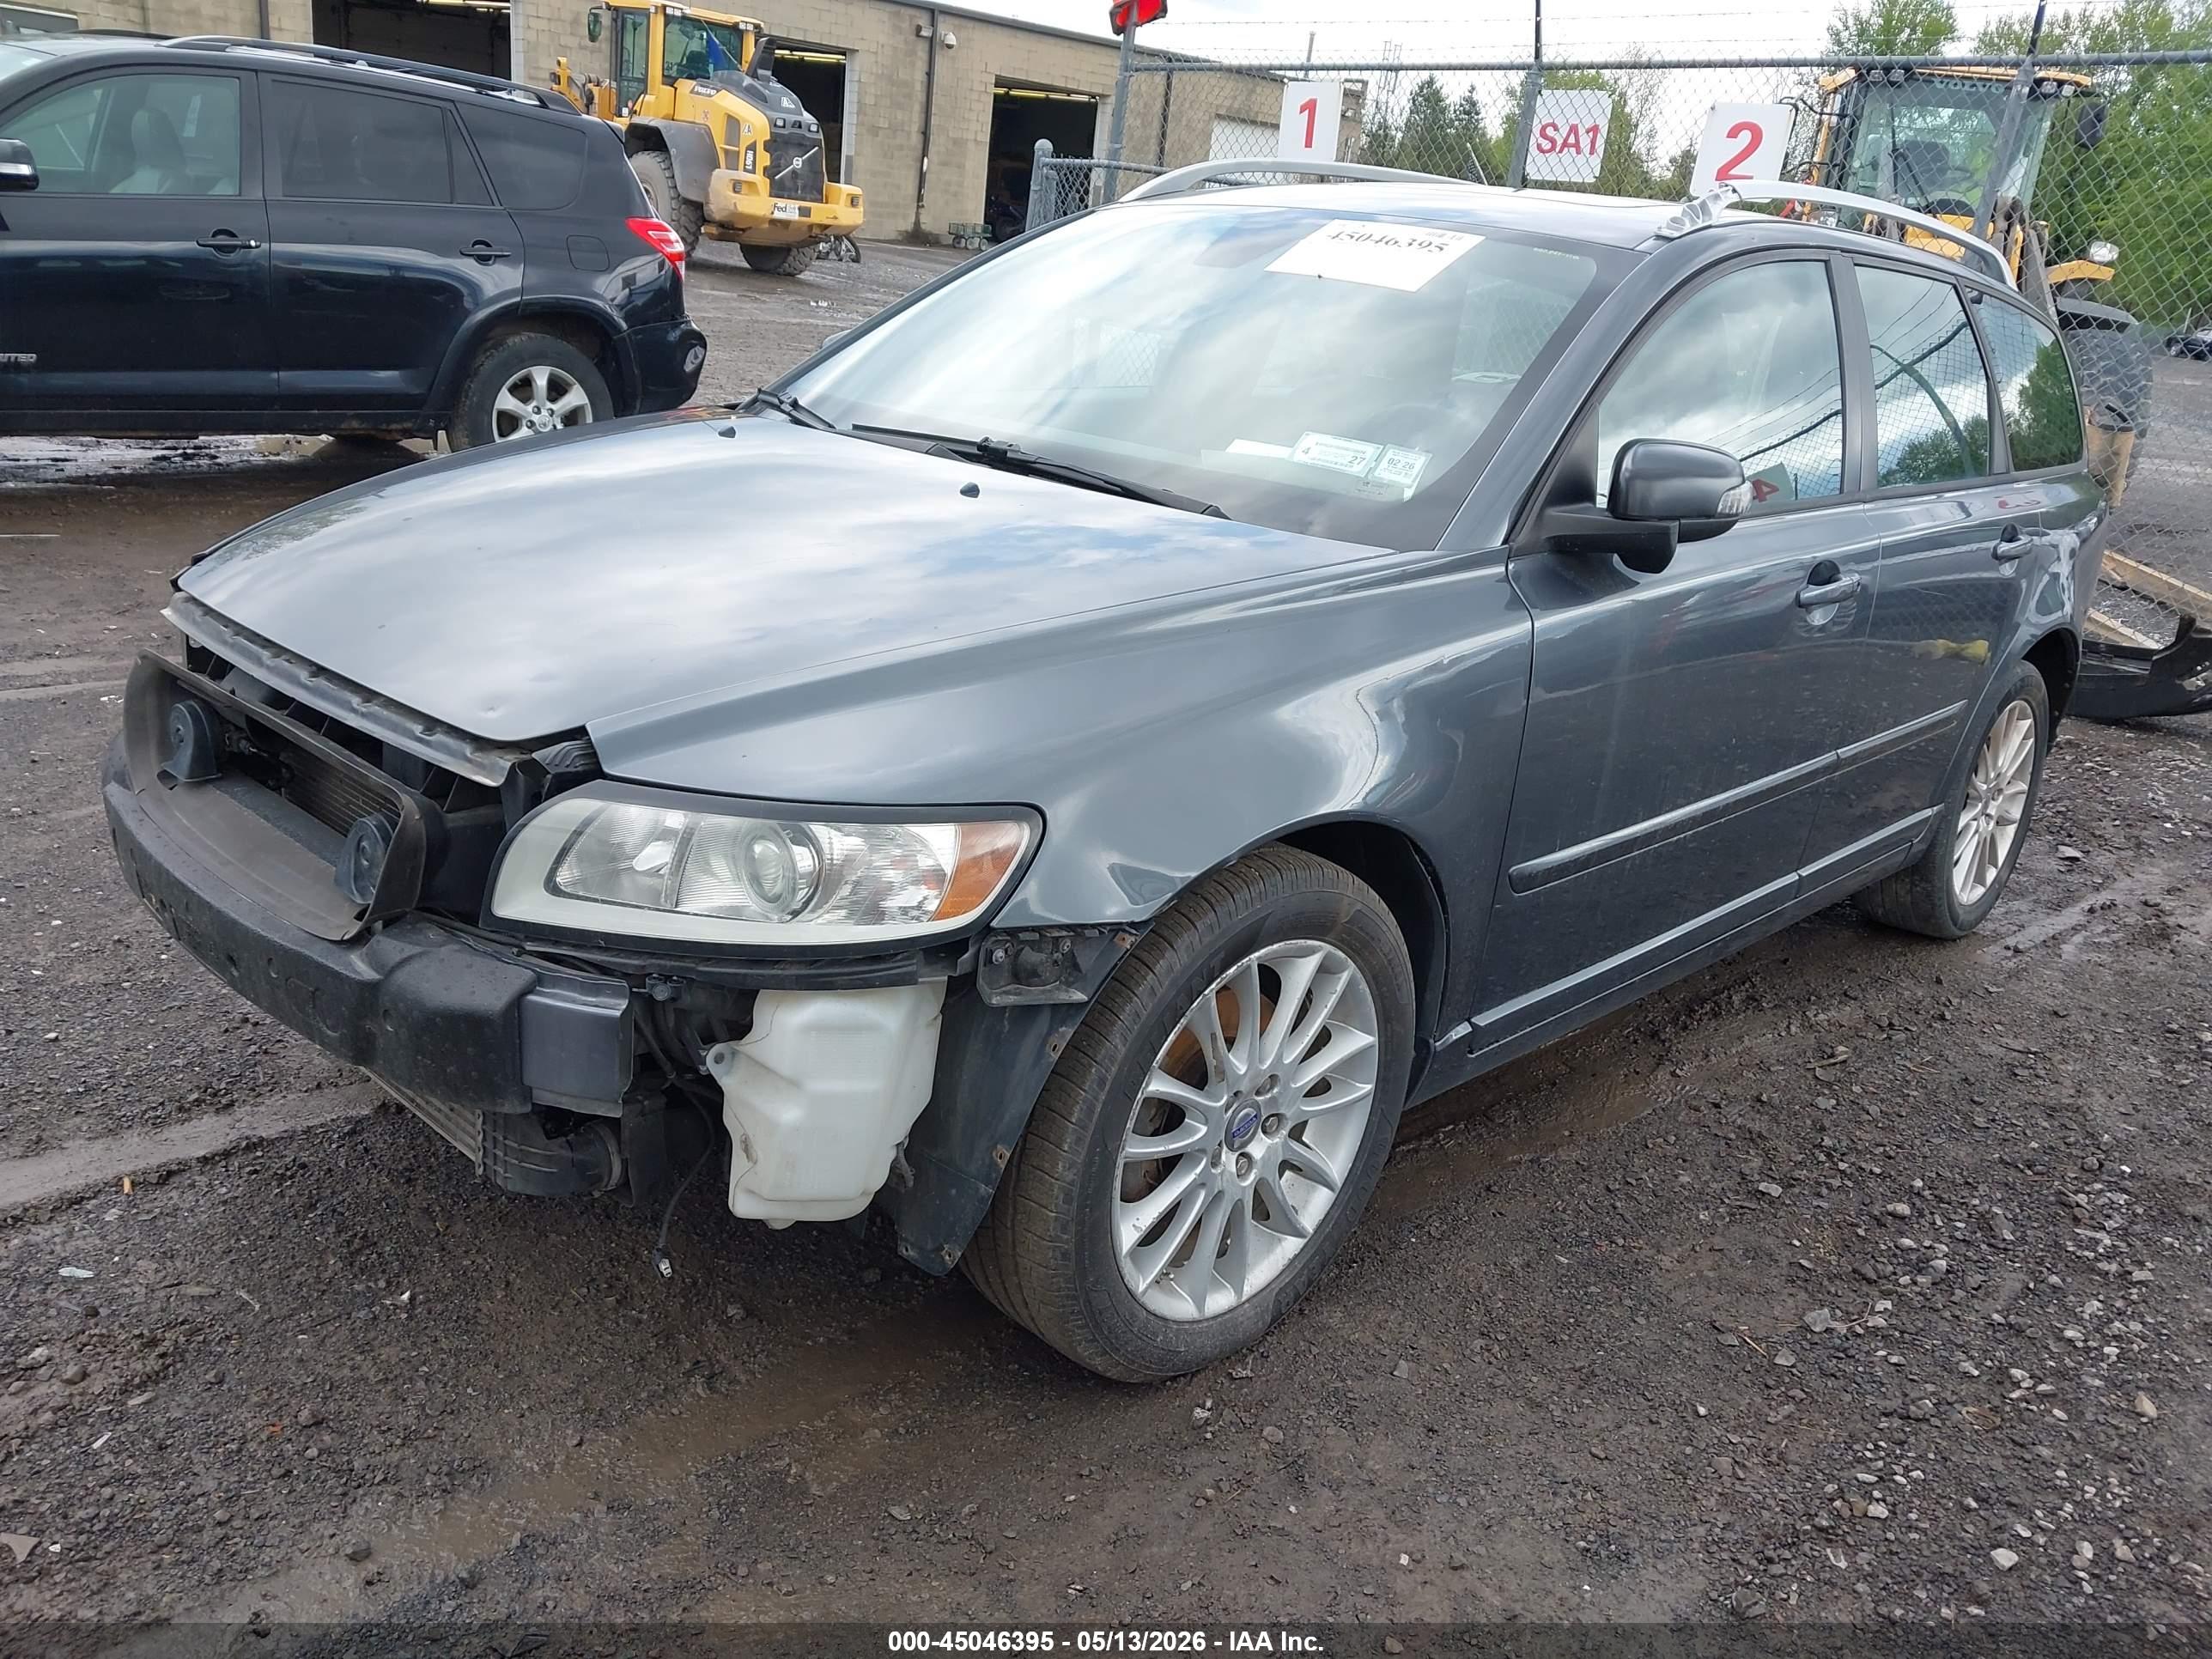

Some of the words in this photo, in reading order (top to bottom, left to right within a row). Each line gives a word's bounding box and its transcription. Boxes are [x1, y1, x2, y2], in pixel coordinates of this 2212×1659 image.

[1931, 78, 2005, 94] VOLVO
[1298, 96, 1318, 149] 1
[1536, 122, 1601, 155] SA1
[1715, 120, 1764, 181] 2
[1348, 455, 1367, 465] 27
